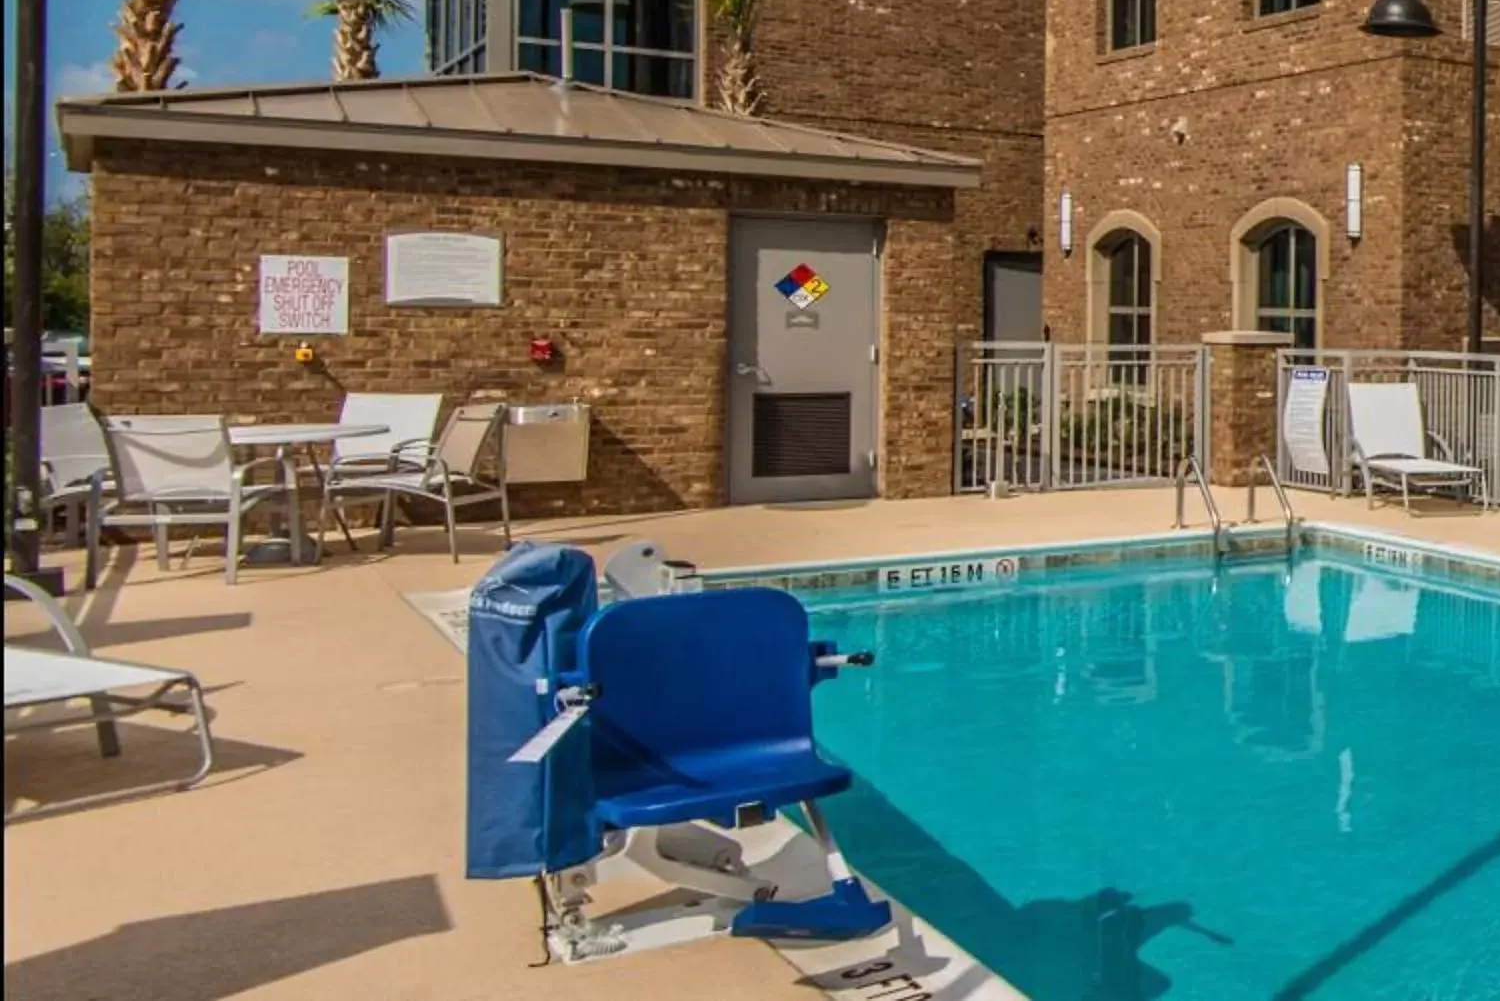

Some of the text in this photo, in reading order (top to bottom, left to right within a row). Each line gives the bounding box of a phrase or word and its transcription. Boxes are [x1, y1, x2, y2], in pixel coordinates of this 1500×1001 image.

[287, 260, 319, 276] POOL
[265, 276, 343, 294] EMERGENCY
[274, 294, 308, 311] SHUT
[279, 311, 330, 328] SWITCH
[841, 962, 893, 979] 3
